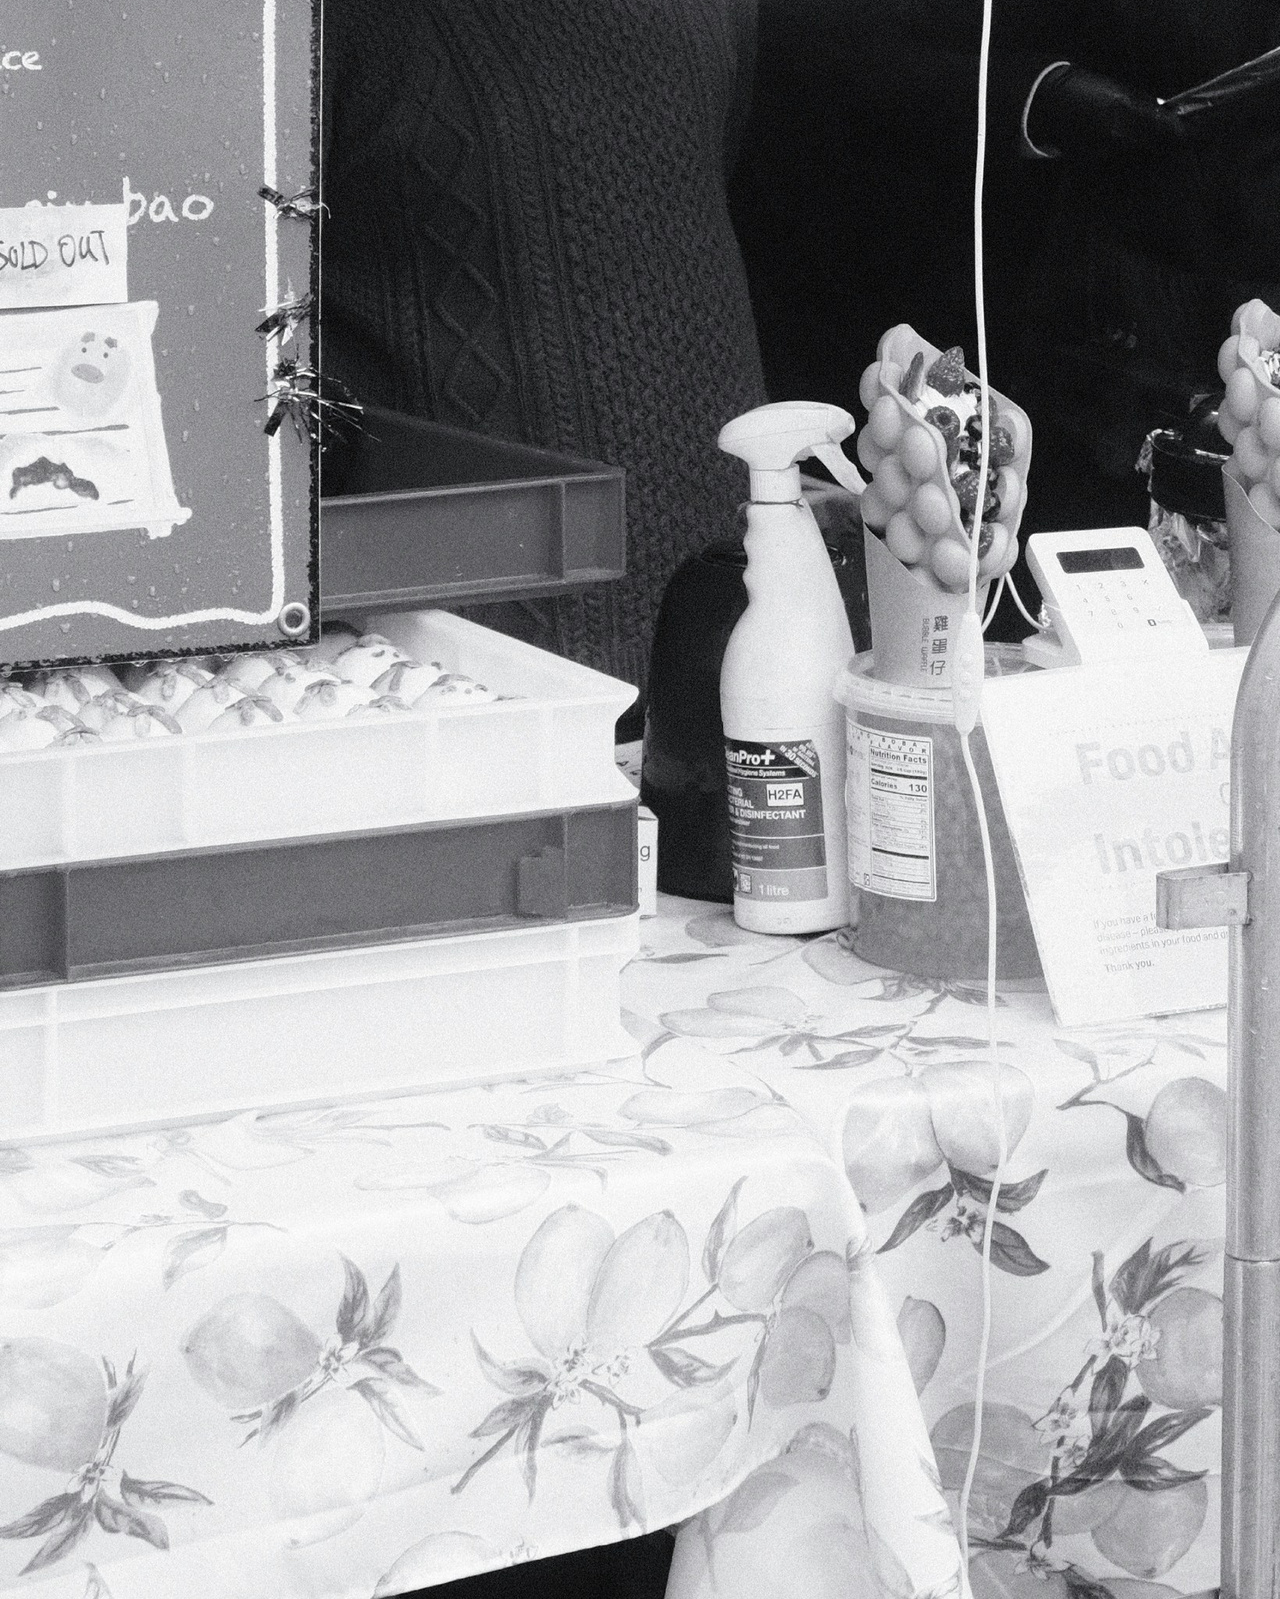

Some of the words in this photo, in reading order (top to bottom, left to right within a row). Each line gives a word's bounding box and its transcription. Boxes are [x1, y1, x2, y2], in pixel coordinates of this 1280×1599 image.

[0, 50, 43, 71] ce
[122, 176, 215, 226] bao
[57, 230, 110, 268] OUT
[783, 748, 797, 762] 30
[870, 748, 902, 761] Nutrition
[903, 754, 927, 764] Facts
[1075, 730, 1195, 785] Food
[870, 778, 898, 790] Calories
[909, 783, 928, 793] 130
[768, 788, 802, 801] H2FA
[740, 808, 807, 820] DISINFECTANT
[766, 884, 790, 897] litre
[1151, 938, 1161, 948] in
[1161, 937, 1180, 949] your
[1182, 932, 1201, 944] food
[1203, 930, 1219, 942] and
[1104, 961, 1134, 974] Thank
[1135, 959, 1155, 971] you.
